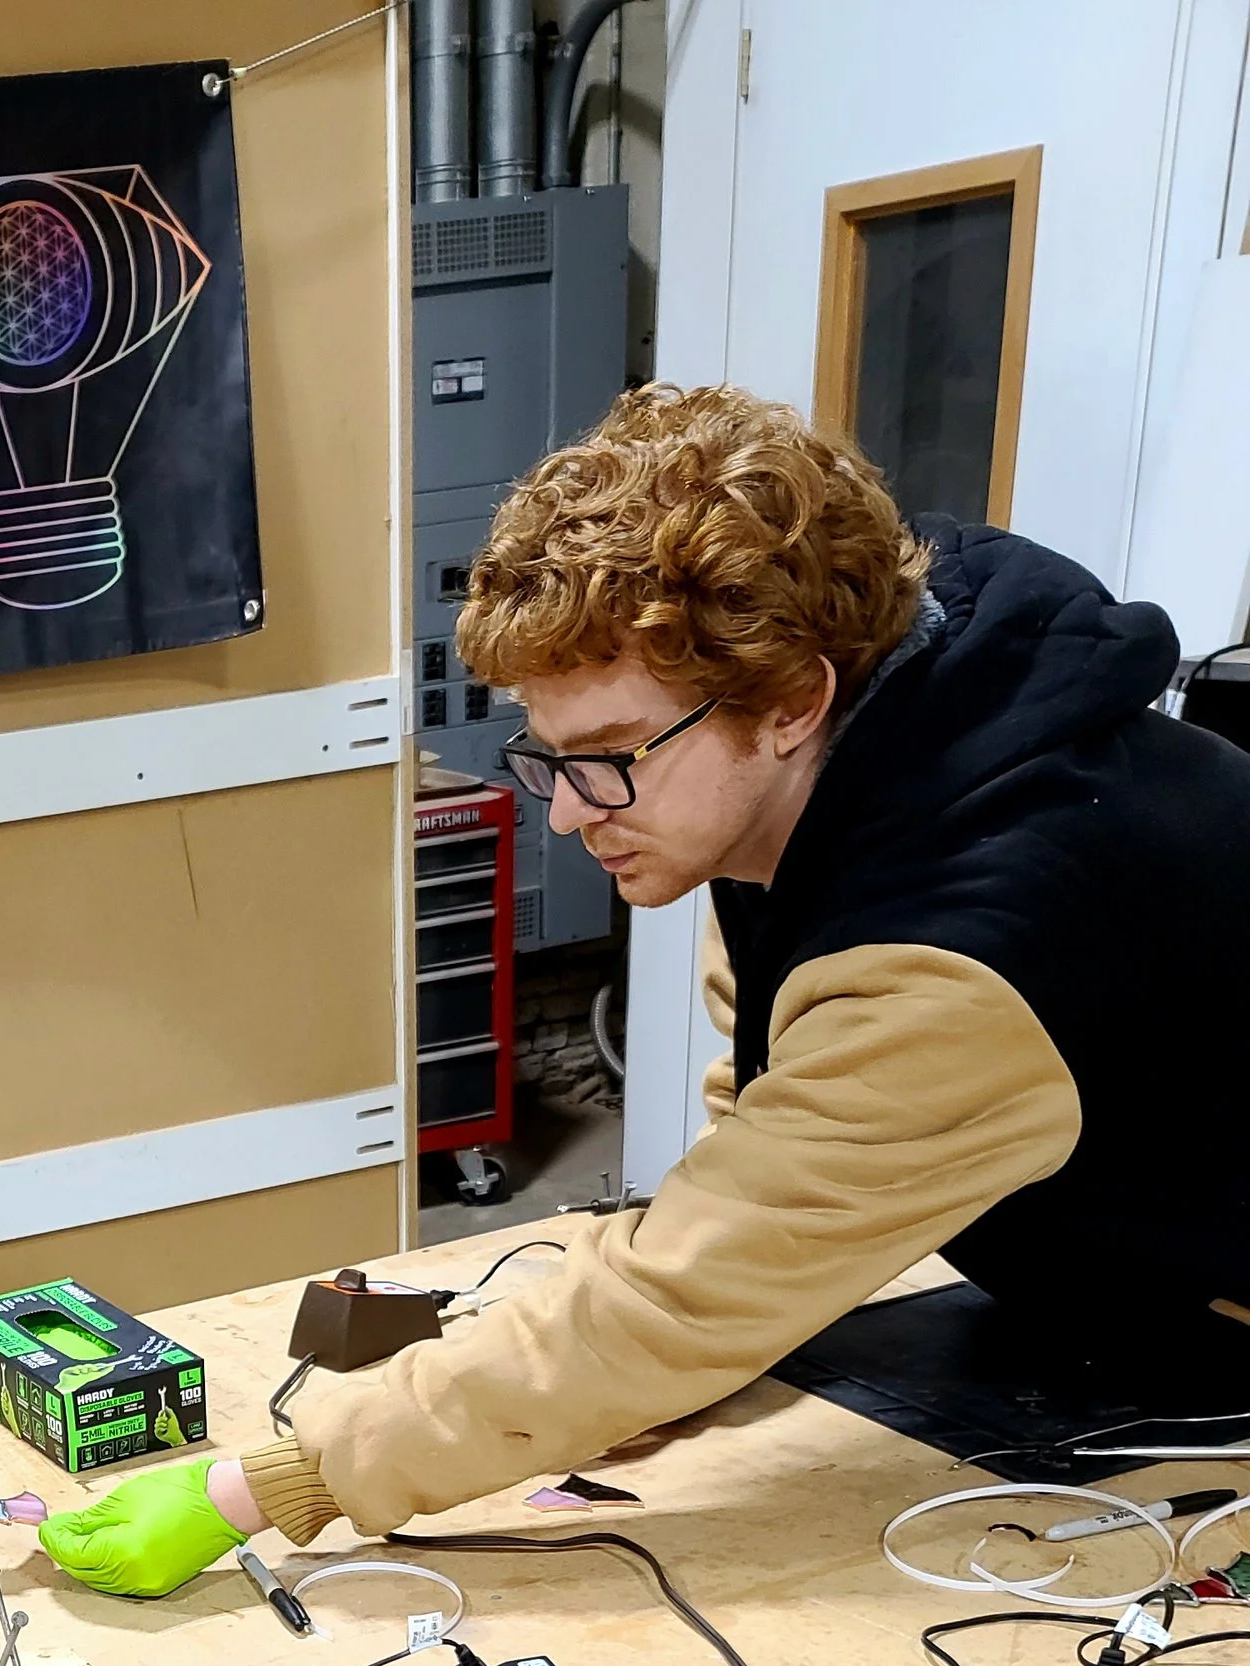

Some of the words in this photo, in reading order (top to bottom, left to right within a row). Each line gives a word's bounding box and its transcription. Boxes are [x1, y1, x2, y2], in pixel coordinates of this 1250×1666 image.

[414, 809, 480, 832] RAFTSMAN
[77, 1388, 115, 1405] HARDY
[180, 1386, 202, 1400] 100
[81, 1432, 89, 1443] 5
[90, 1427, 105, 1437] MIL
[109, 1421, 144, 1437] NITRILE
